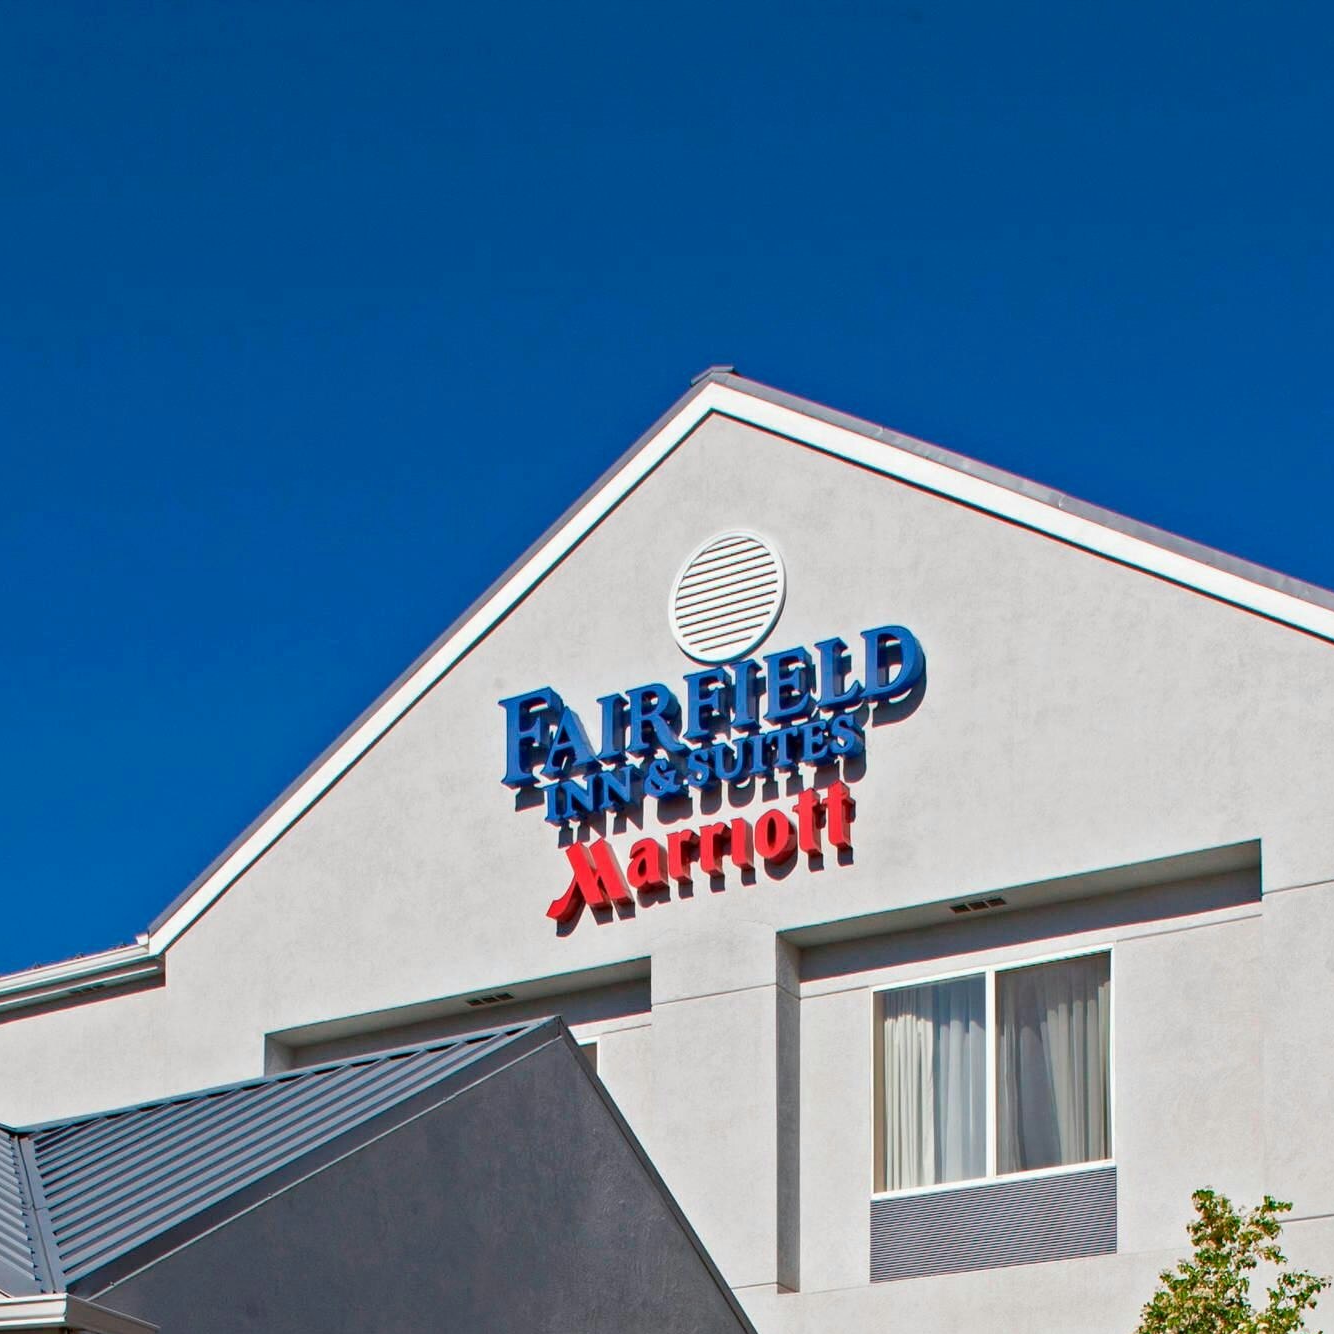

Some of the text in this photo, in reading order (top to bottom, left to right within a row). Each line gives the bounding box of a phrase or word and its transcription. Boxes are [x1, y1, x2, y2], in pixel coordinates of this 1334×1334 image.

[498, 624, 925, 788] FAIRFIELD
[544, 714, 865, 826] INN & SUITES
[546, 779, 856, 922] Marriott
